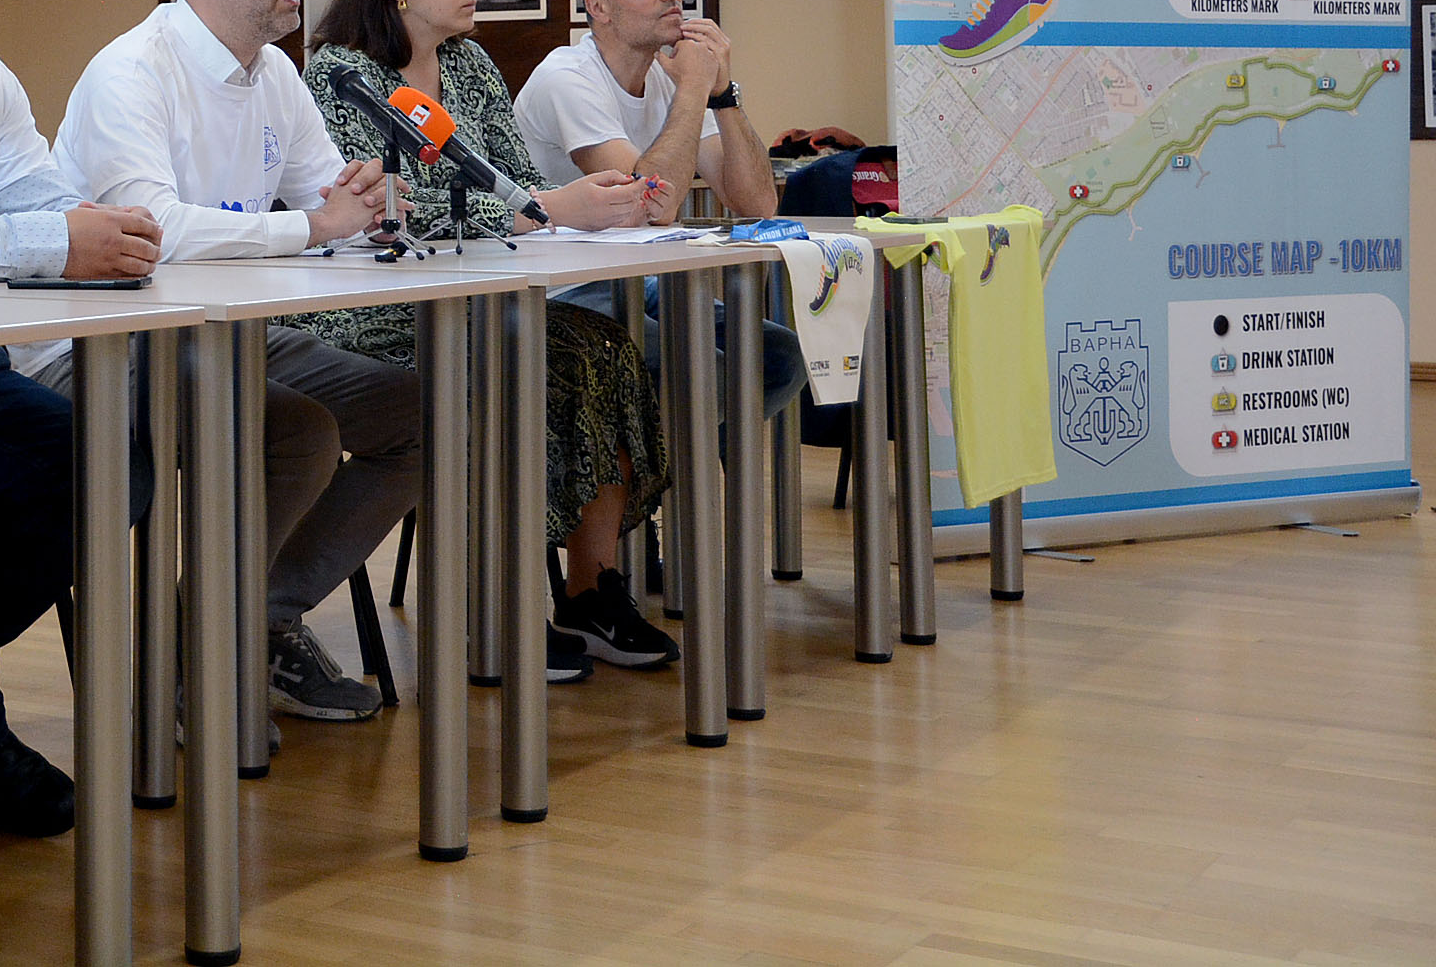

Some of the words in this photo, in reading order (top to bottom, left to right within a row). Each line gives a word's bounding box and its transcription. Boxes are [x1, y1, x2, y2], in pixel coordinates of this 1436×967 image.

[1250, 0, 1279, 14] MARK
[1313, 0, 1371, 15] KILOMETERS
[1373, 1, 1401, 16] MARK
[1168, 242, 1264, 279] COURSE
[1270, 240, 1323, 275] MAP
[1242, 310, 1325, 332] START/FINISH
[1070, 336, 1136, 353] ВАРНА
[1242, 350, 1283, 370] DRINK
[1287, 347, 1335, 367] STATION
[1243, 389, 1318, 411] RESTROOMS
[1322, 387, 1350, 409] (WC)
[1243, 425, 1298, 447] MEDICAL
[1302, 421, 1350, 443] STATION
